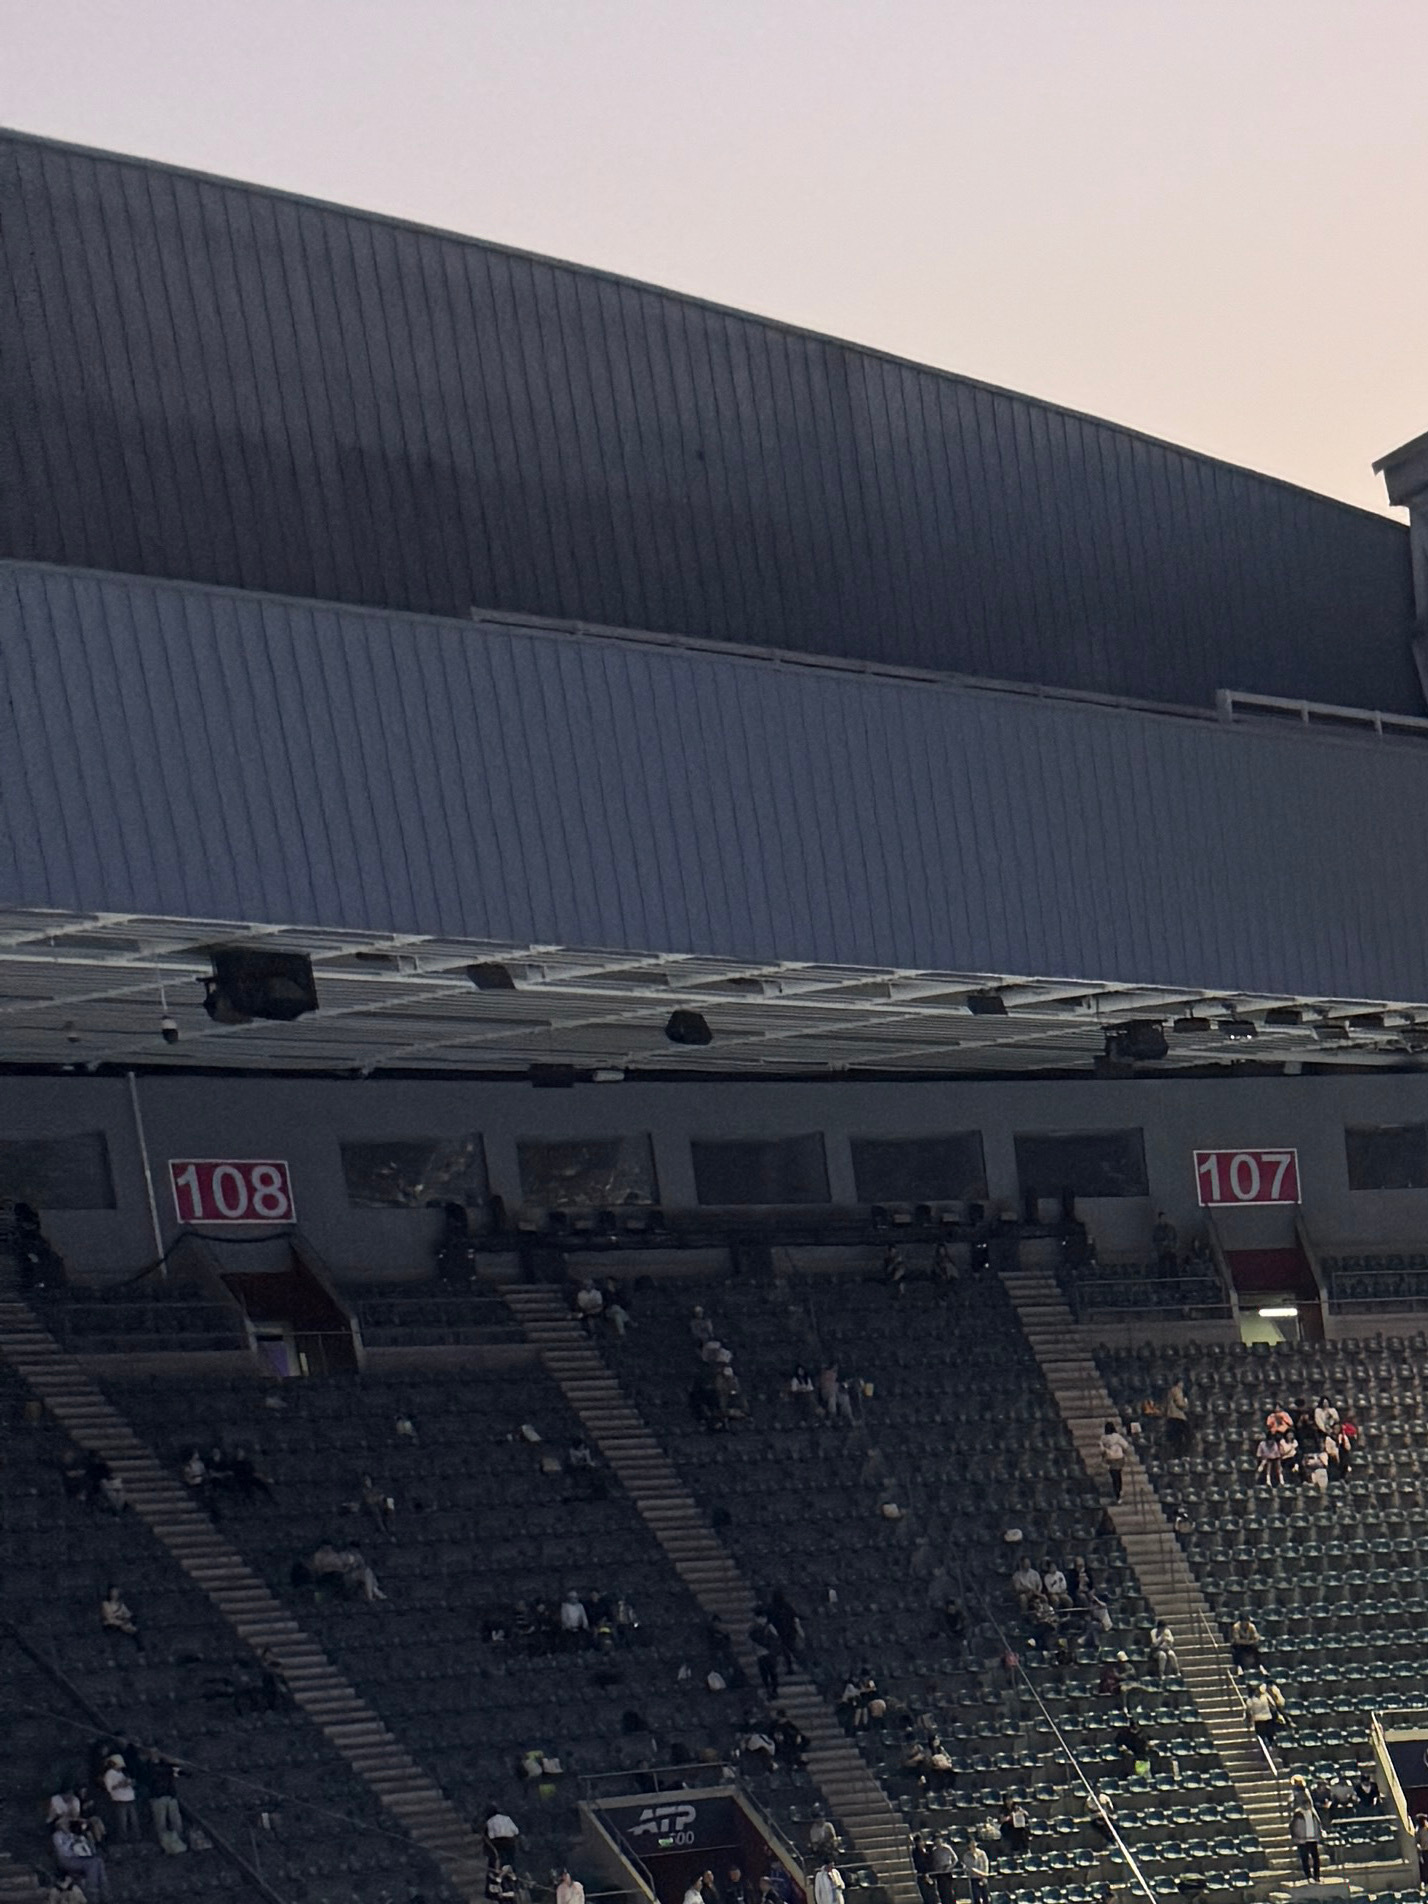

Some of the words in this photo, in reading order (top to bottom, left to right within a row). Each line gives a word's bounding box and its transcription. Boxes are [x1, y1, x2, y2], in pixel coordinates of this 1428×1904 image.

[176, 1165, 289, 1218] 108
[1198, 1154, 1291, 1200] 107
[627, 1805, 696, 1836] ATP
